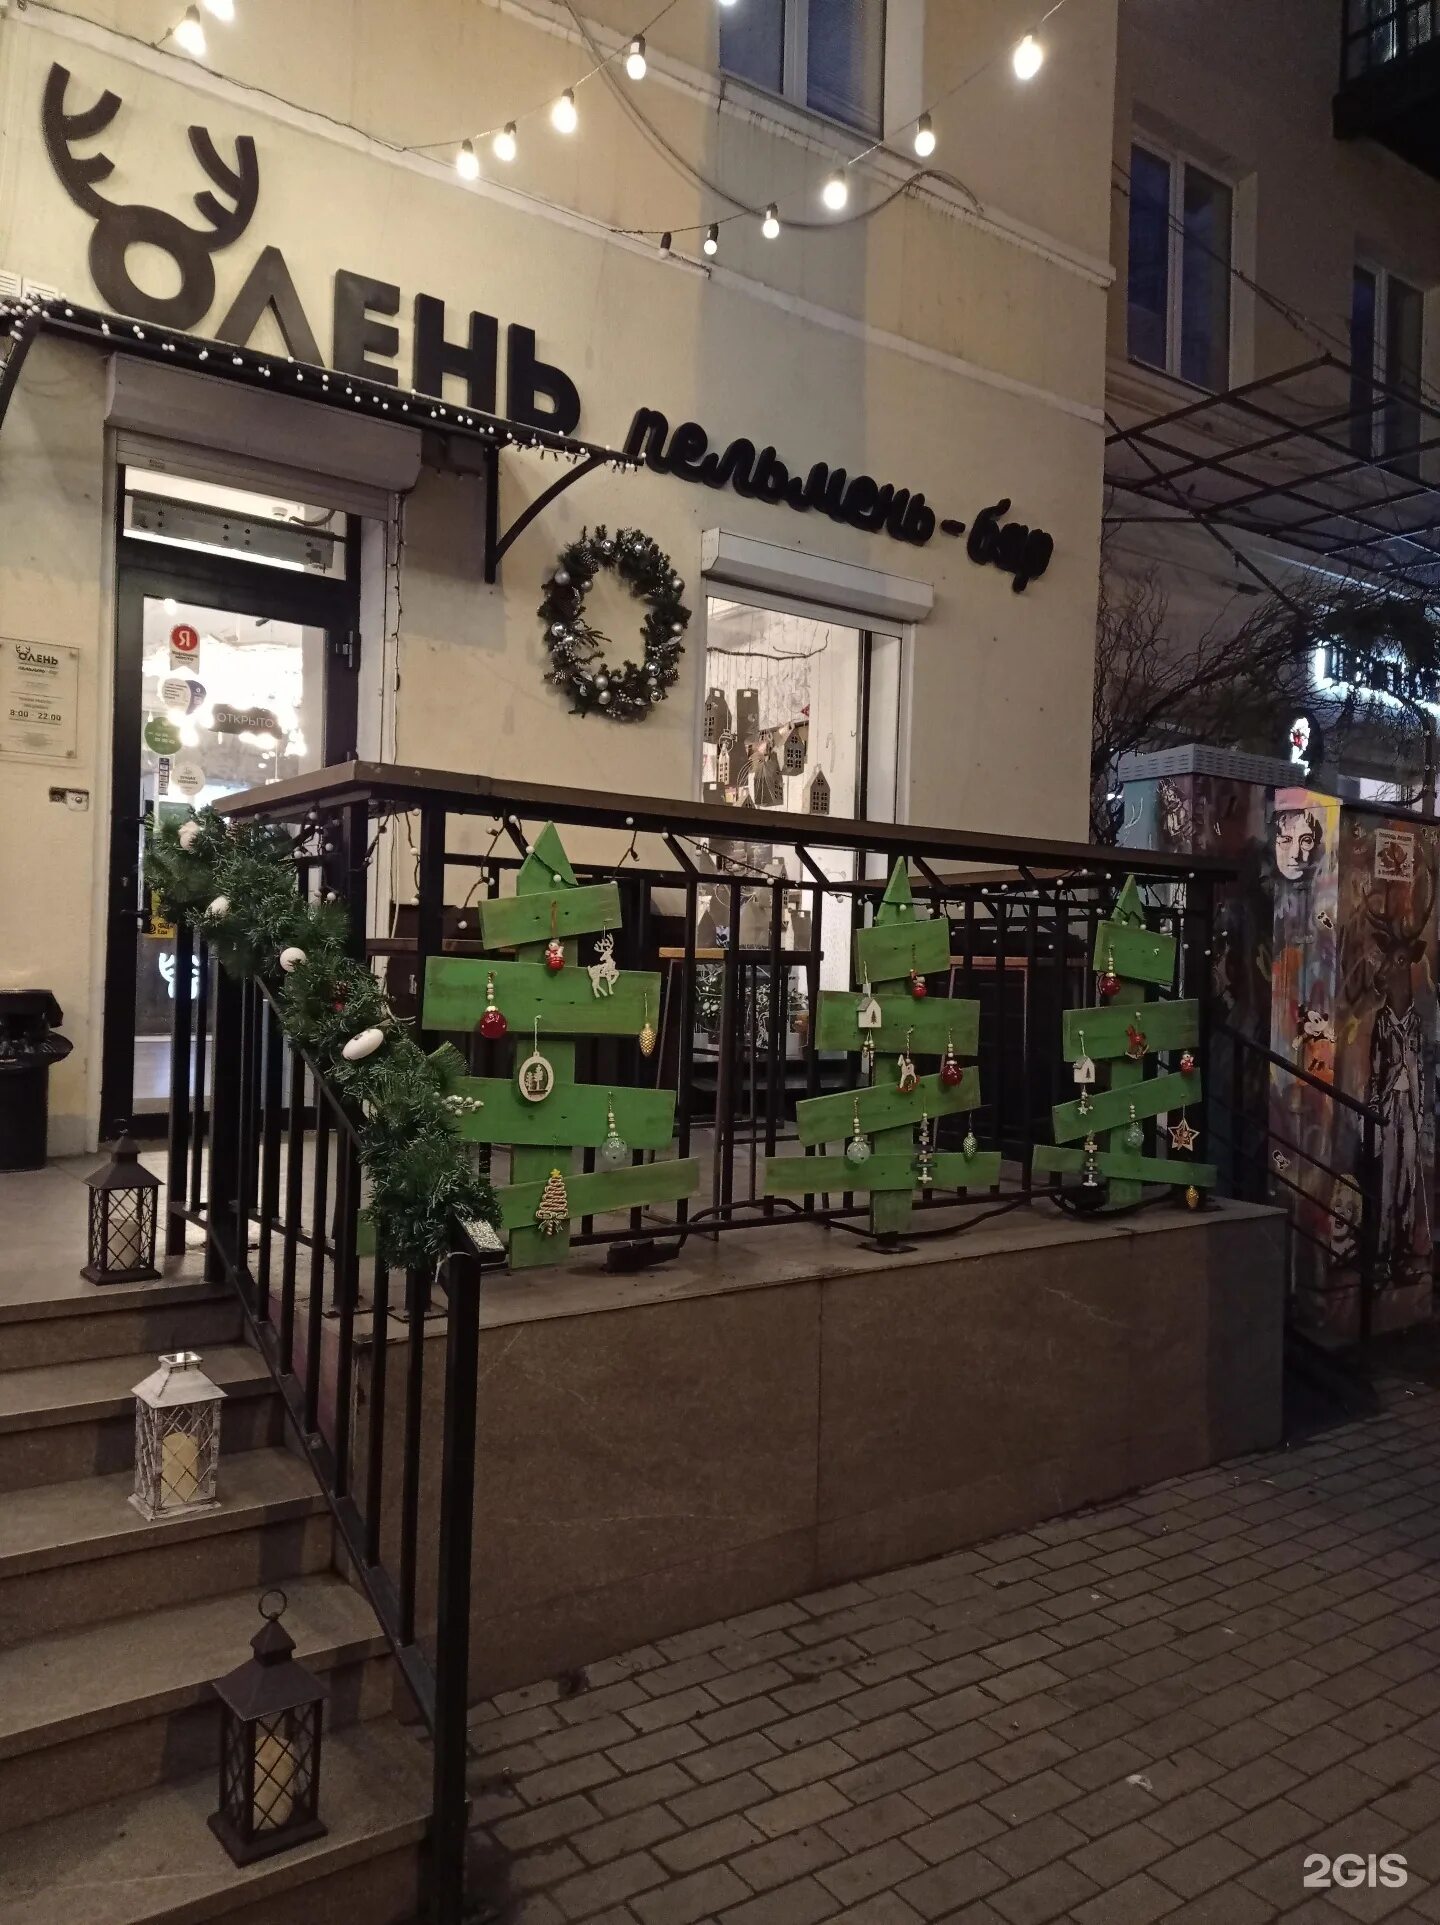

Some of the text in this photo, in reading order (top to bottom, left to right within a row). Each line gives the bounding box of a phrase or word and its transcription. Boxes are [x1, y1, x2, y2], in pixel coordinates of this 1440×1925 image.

[88, 203, 581, 436] ОЛЕНЬ
[178, 630, 191, 648] Я
[18, 652, 59, 666] ОЛЕНЬ
[216, 712, 274, 728] ОТКРЫТО
